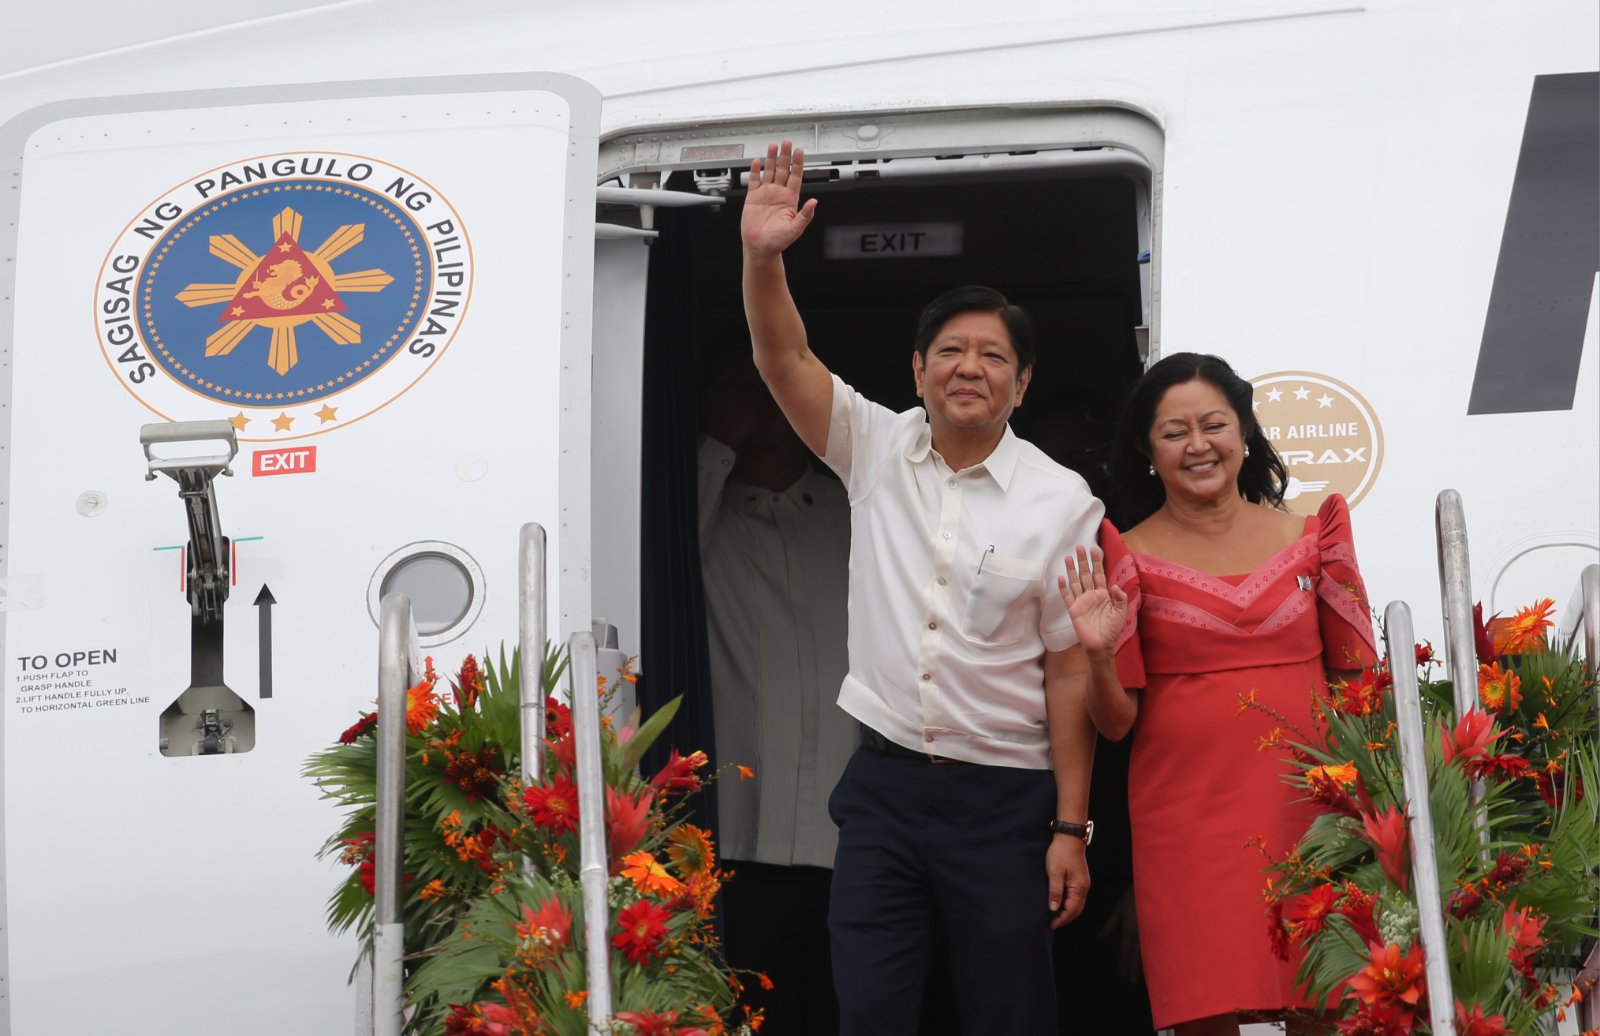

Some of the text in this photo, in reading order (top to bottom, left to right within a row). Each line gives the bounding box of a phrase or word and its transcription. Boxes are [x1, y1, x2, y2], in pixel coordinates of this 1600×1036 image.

[859, 232, 926, 252] EXIT
[104, 158, 464, 384] SAGISAG NG PANGULO NG PILIPINAS
[1287, 422, 1358, 439] AIRLINE
[260, 450, 310, 472] EXIT
[17, 648, 117, 671] TO OPEN
[50, 671, 74, 679] FLAP
[76, 669, 89, 677] TO
[20, 680, 92, 692] GRASP HANDLE
[44, 691, 82, 701] HANDLE
[84, 688, 112, 698] FULLY
[35, 702, 93, 712] HORIZONTAL
[96, 698, 128, 707] GREEN
[130, 696, 151, 704] LINE
